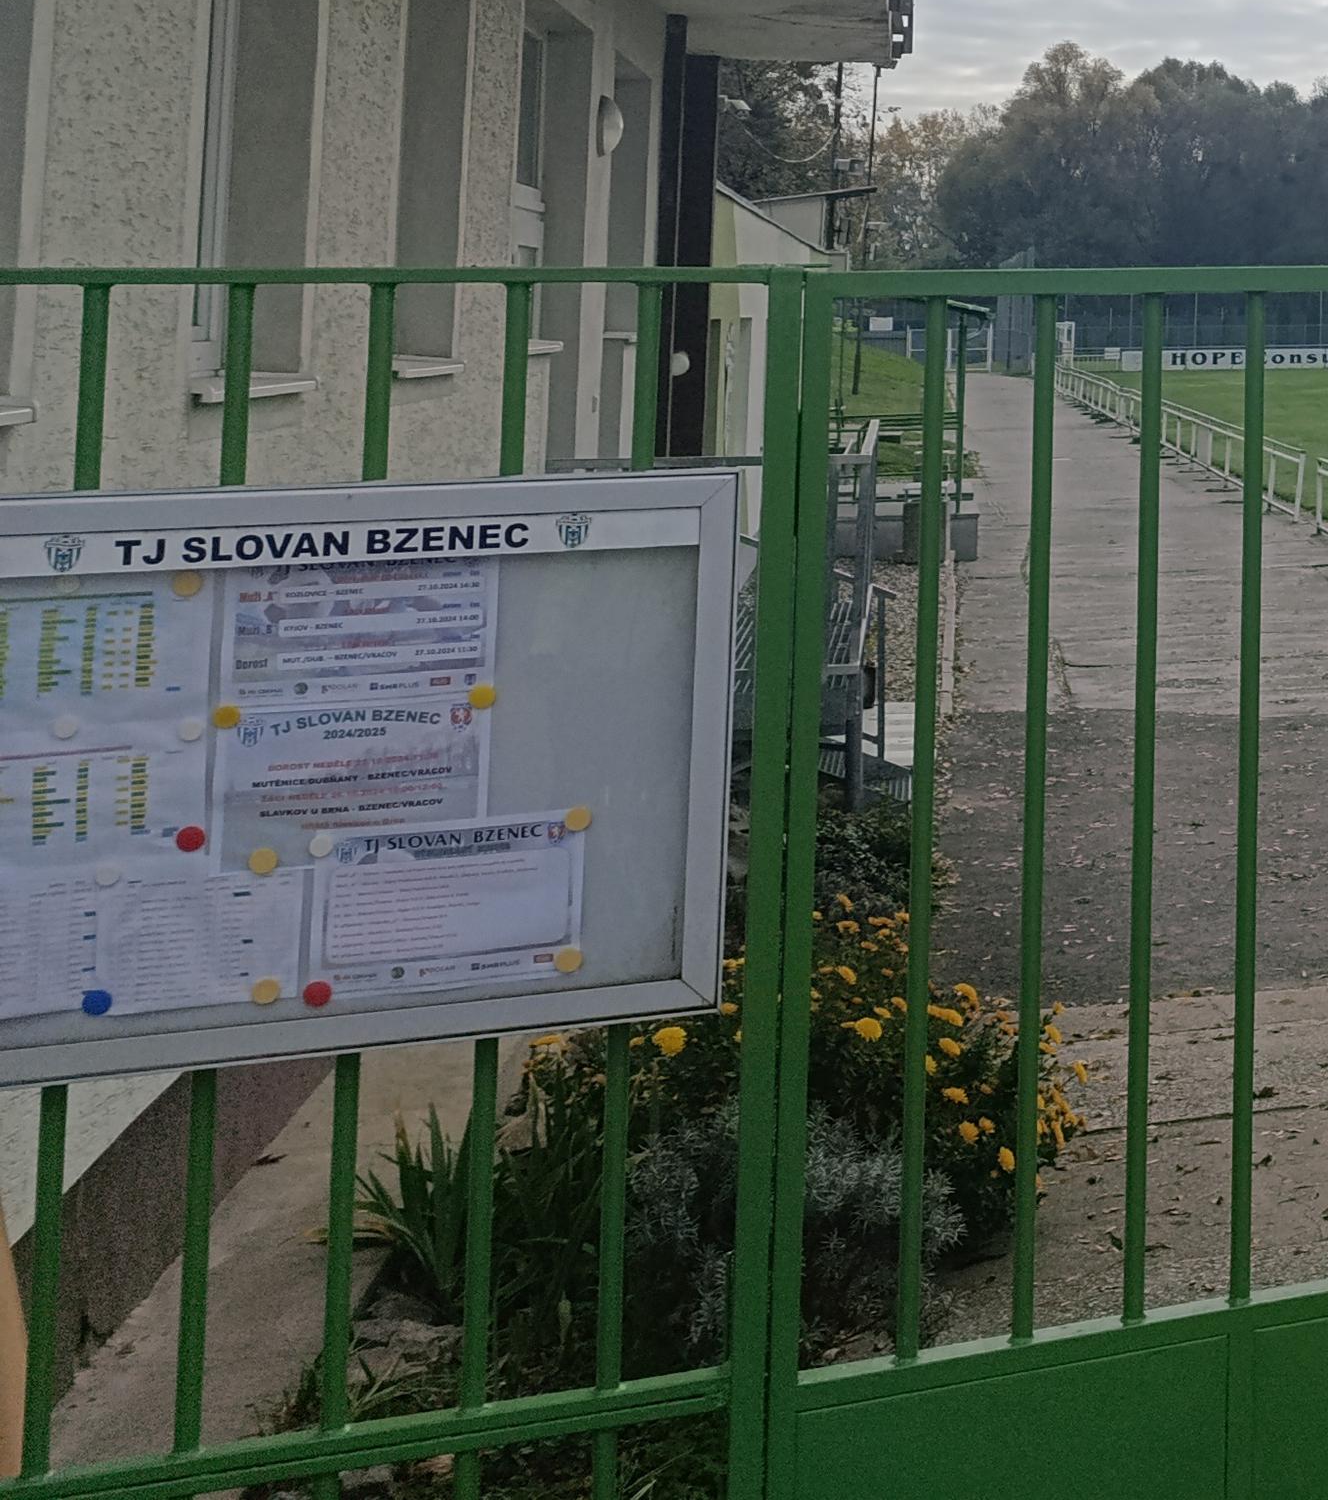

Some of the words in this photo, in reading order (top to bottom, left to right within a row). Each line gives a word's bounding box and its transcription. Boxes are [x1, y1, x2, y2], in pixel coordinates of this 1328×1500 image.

[1171, 352, 1243, 366] HOPE
[115, 538, 167, 567] TJ
[181, 528, 351, 563] SLOVAN
[366, 522, 530, 555] BZENEC
[270, 723, 292, 736] TJ
[296, 709, 367, 730] SLOVAN
[372, 709, 442, 725] BZENEC
[323, 727, 387, 740] 2024/2025
[259, 807, 308, 818] SLAVKOV
[364, 838, 380, 855] TJ
[386, 830, 463, 850] SLOVAN
[473, 823, 543, 844] BZENEC
